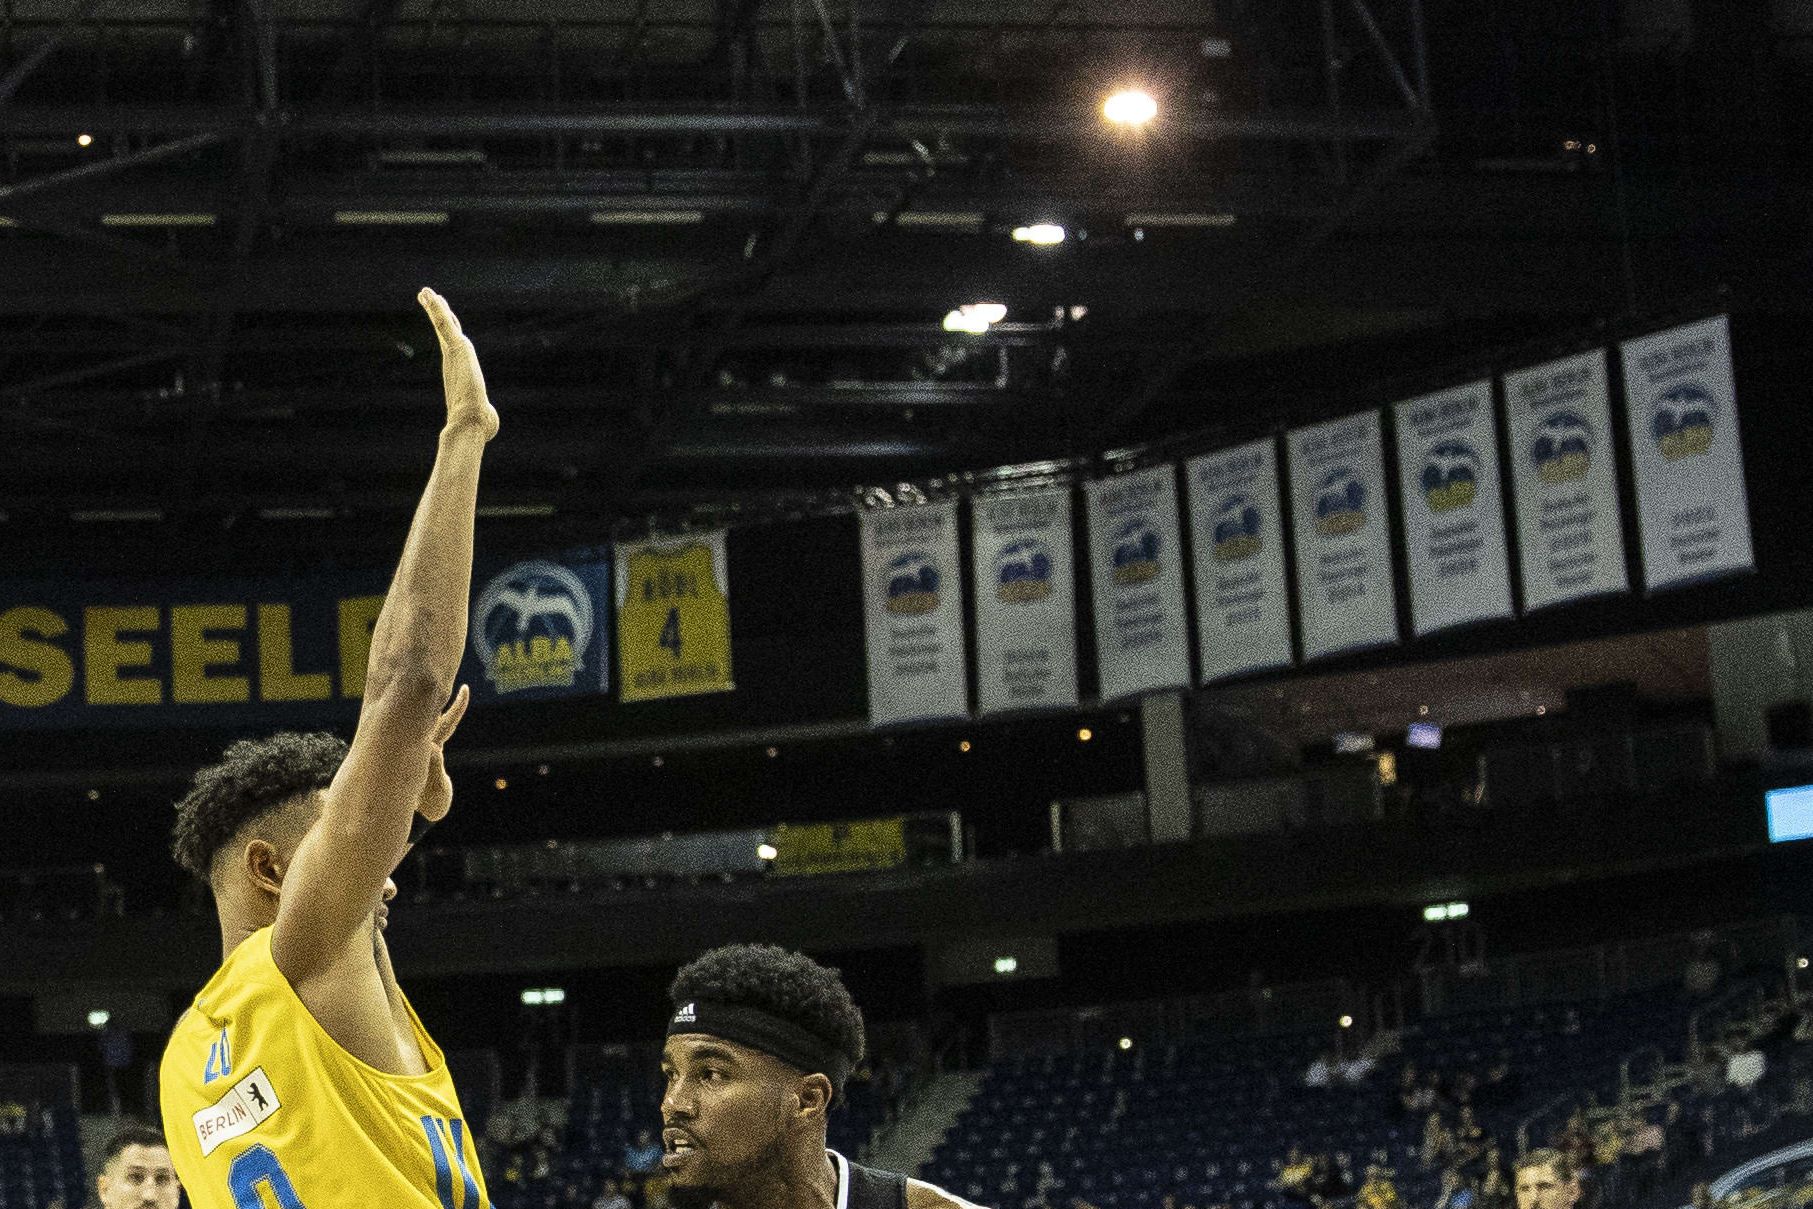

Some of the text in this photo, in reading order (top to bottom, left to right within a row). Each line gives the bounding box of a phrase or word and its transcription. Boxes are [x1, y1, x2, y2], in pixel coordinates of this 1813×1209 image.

[496, 636, 574, 667] ALBA
[659, 608, 683, 660] 4
[199, 1102, 247, 1141] BERLIN
